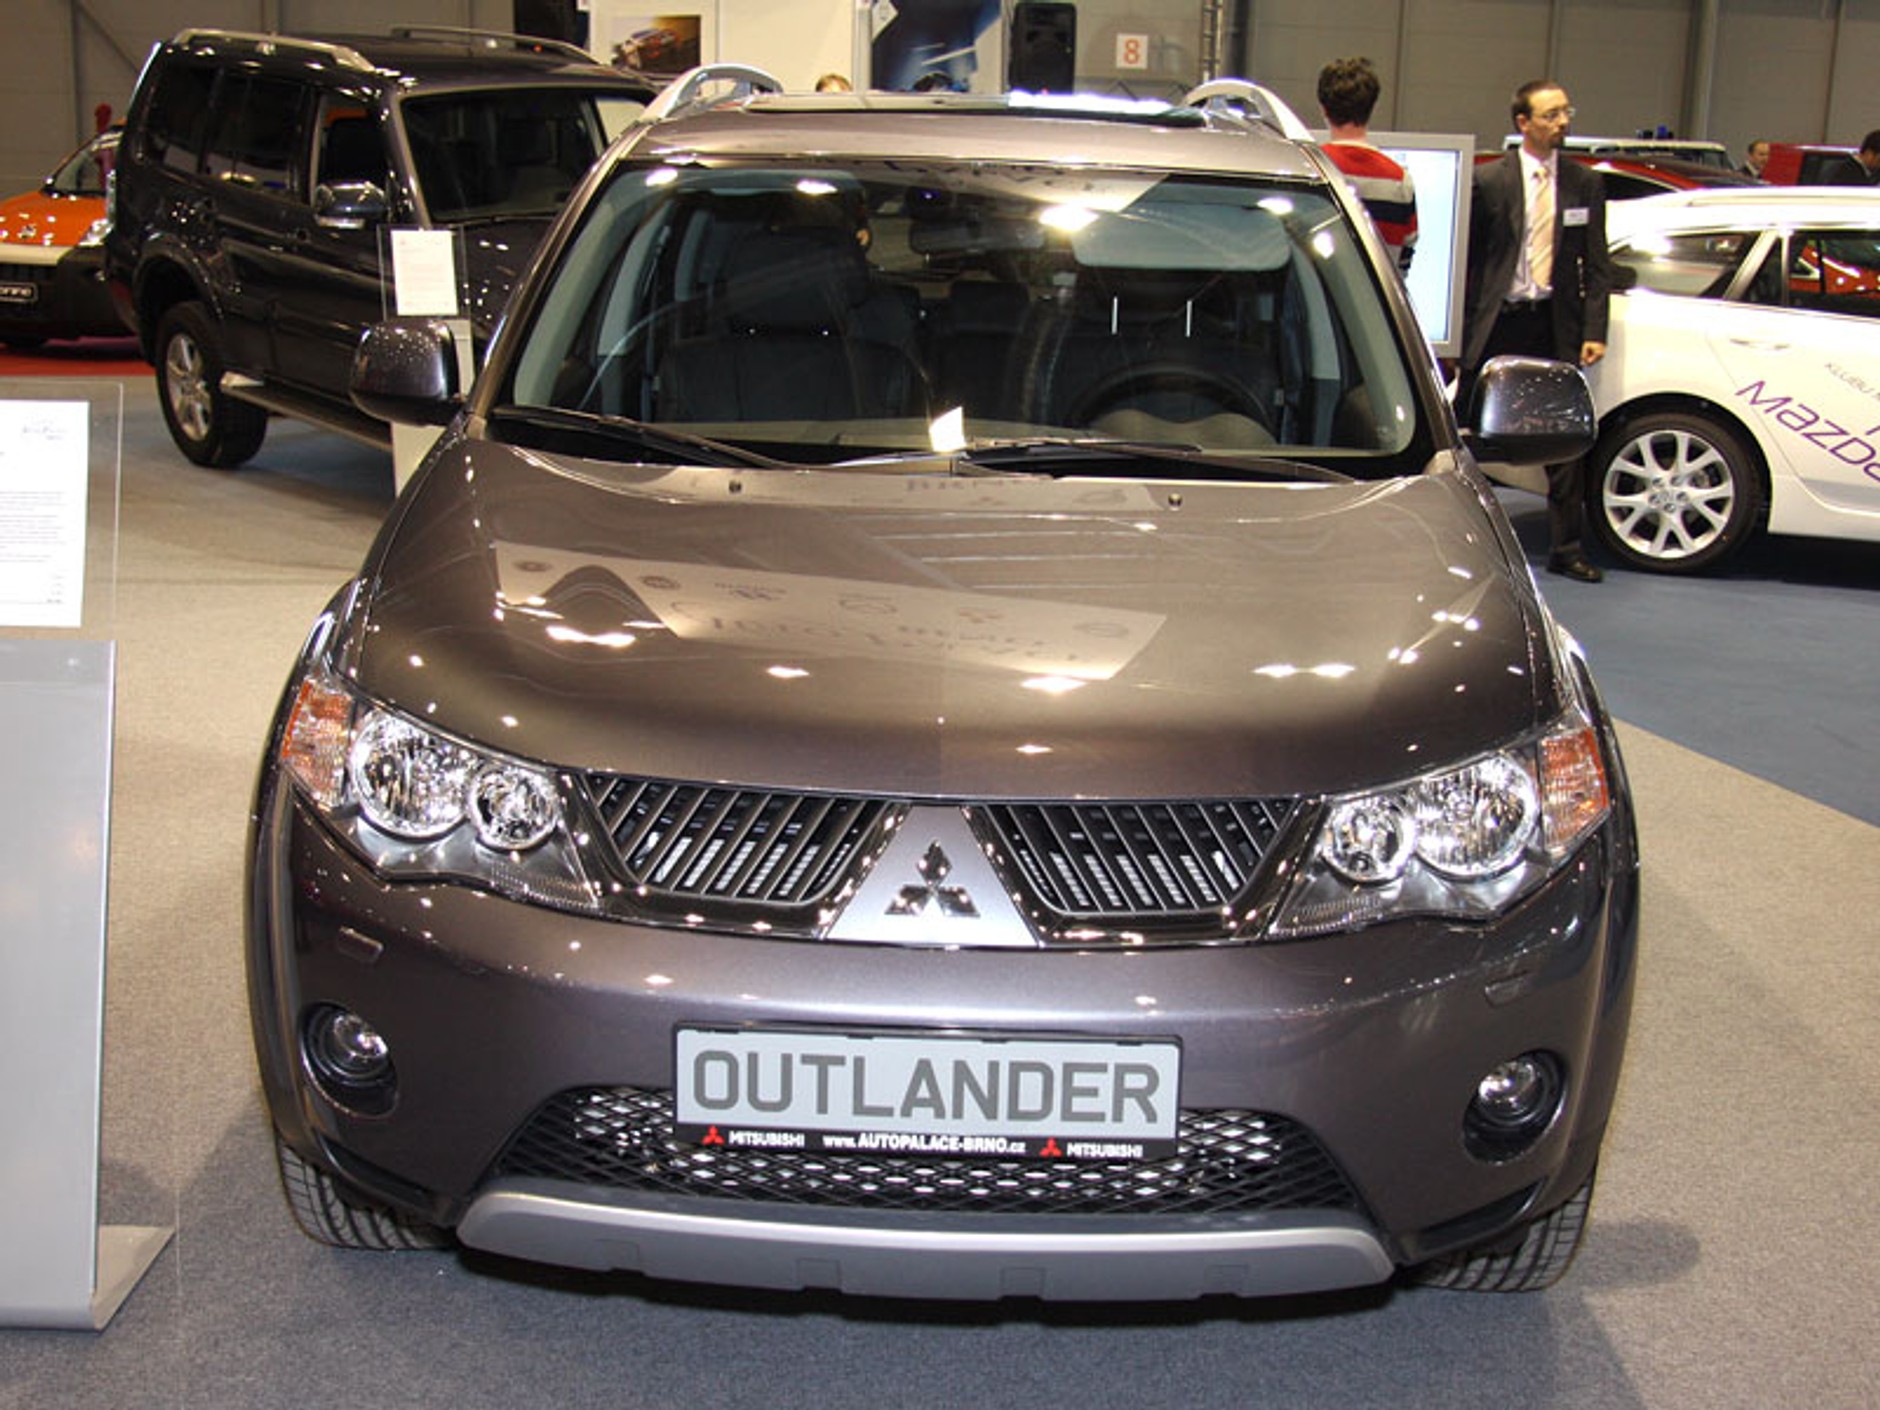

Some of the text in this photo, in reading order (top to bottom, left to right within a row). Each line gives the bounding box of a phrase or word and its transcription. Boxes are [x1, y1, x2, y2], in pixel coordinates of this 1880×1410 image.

[1123, 38, 1141, 65] 8
[693, 1050, 1160, 1123] OUTLANDER
[728, 1130, 805, 1147] MITSUBISHI
[1066, 1142, 1143, 1158] MITSUBISHI
